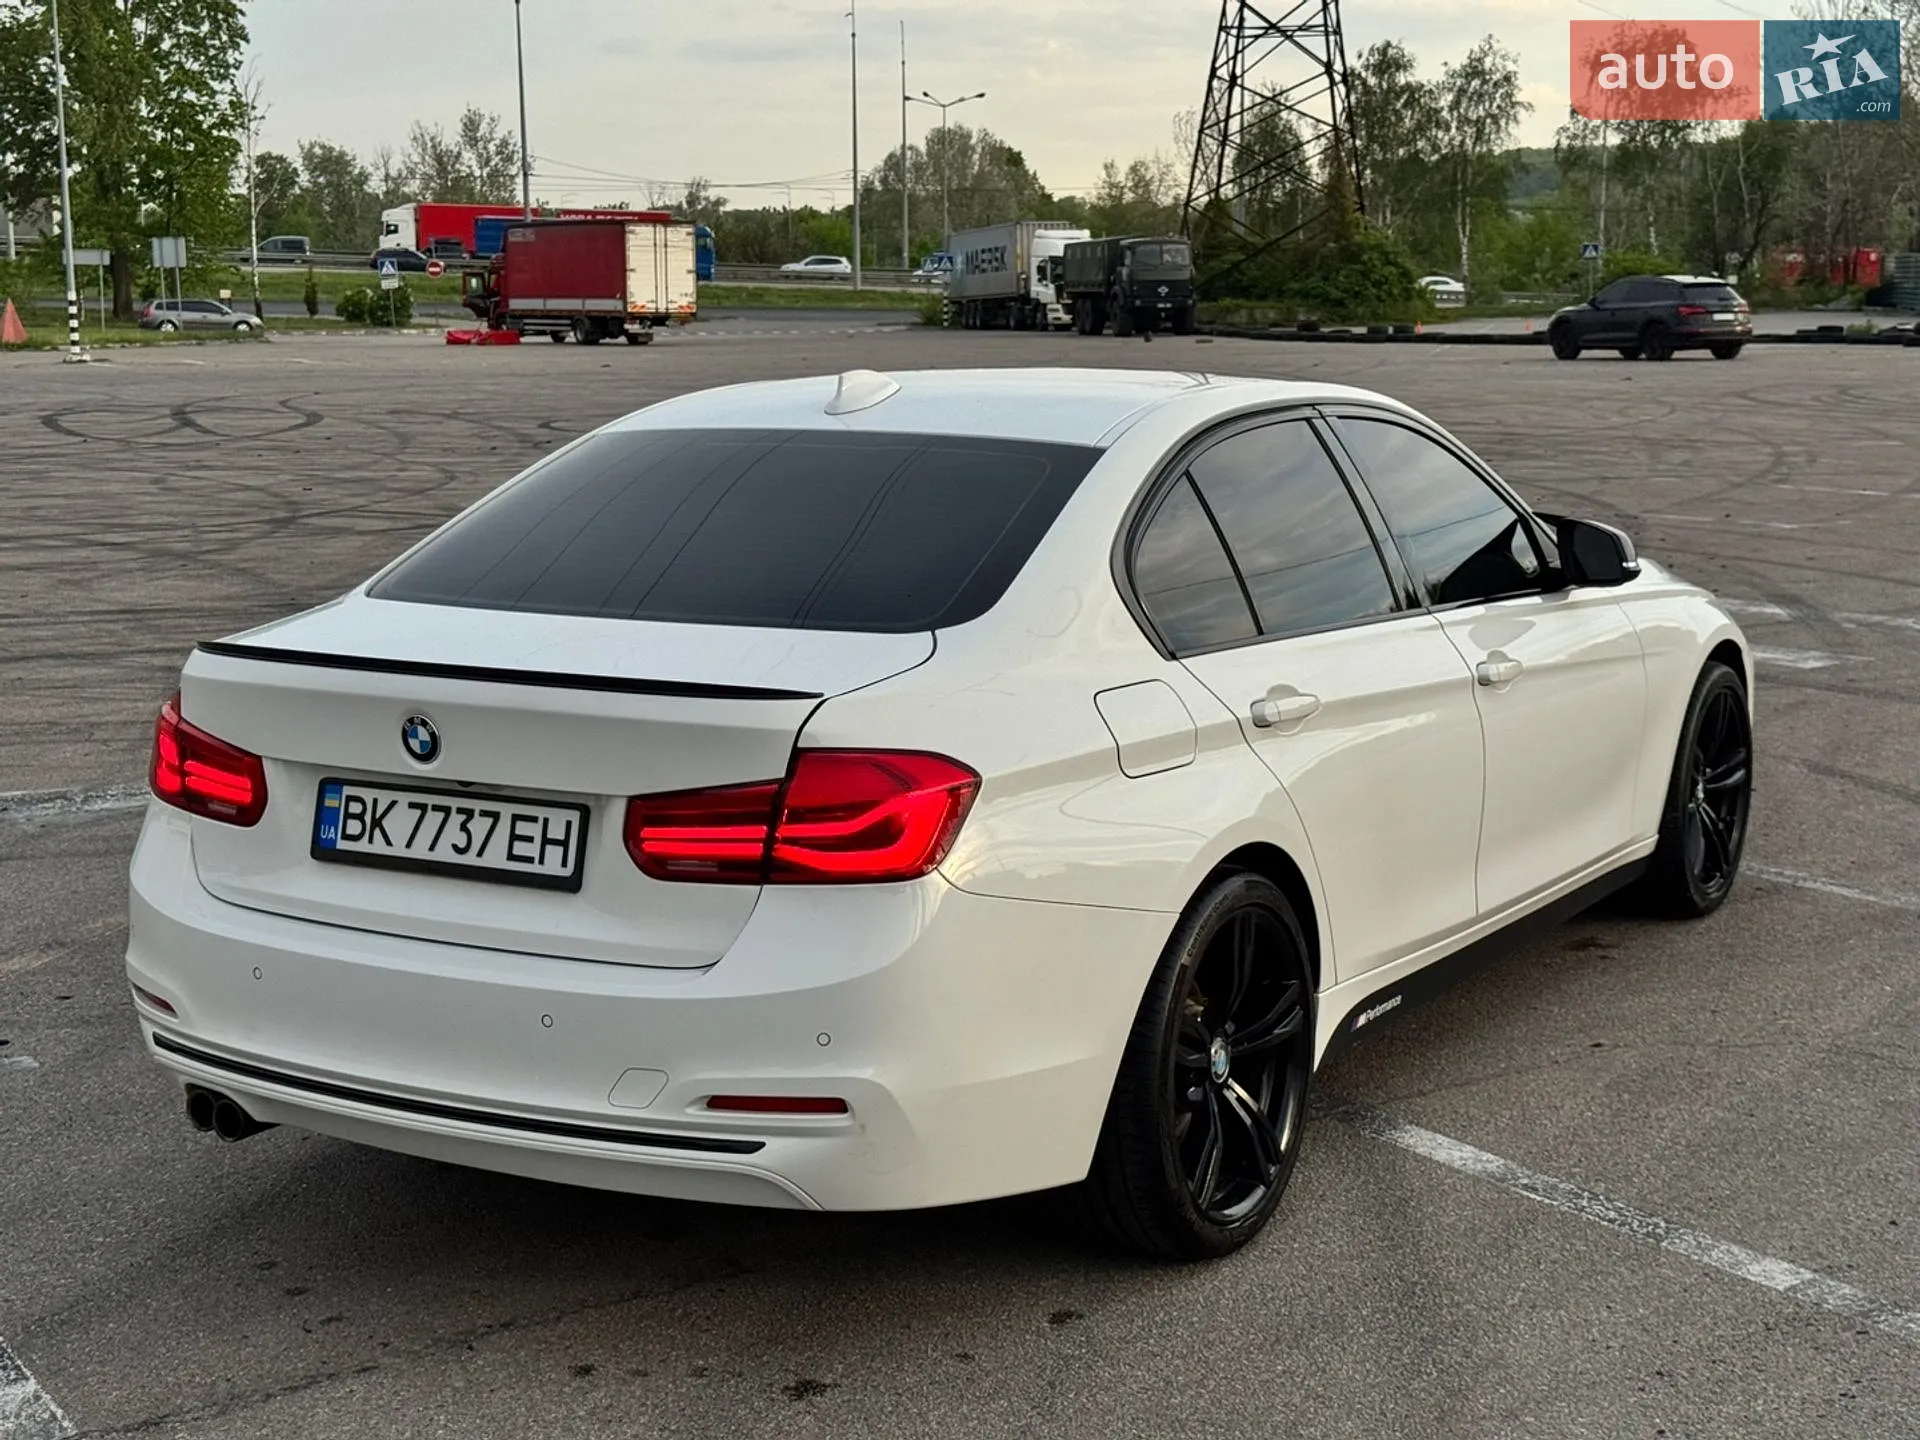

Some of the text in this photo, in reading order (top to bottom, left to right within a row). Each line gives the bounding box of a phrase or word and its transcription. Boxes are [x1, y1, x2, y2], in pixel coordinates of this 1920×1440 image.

[320, 824, 336, 841] UA
[340, 794, 573, 868] BK 7737 EH
